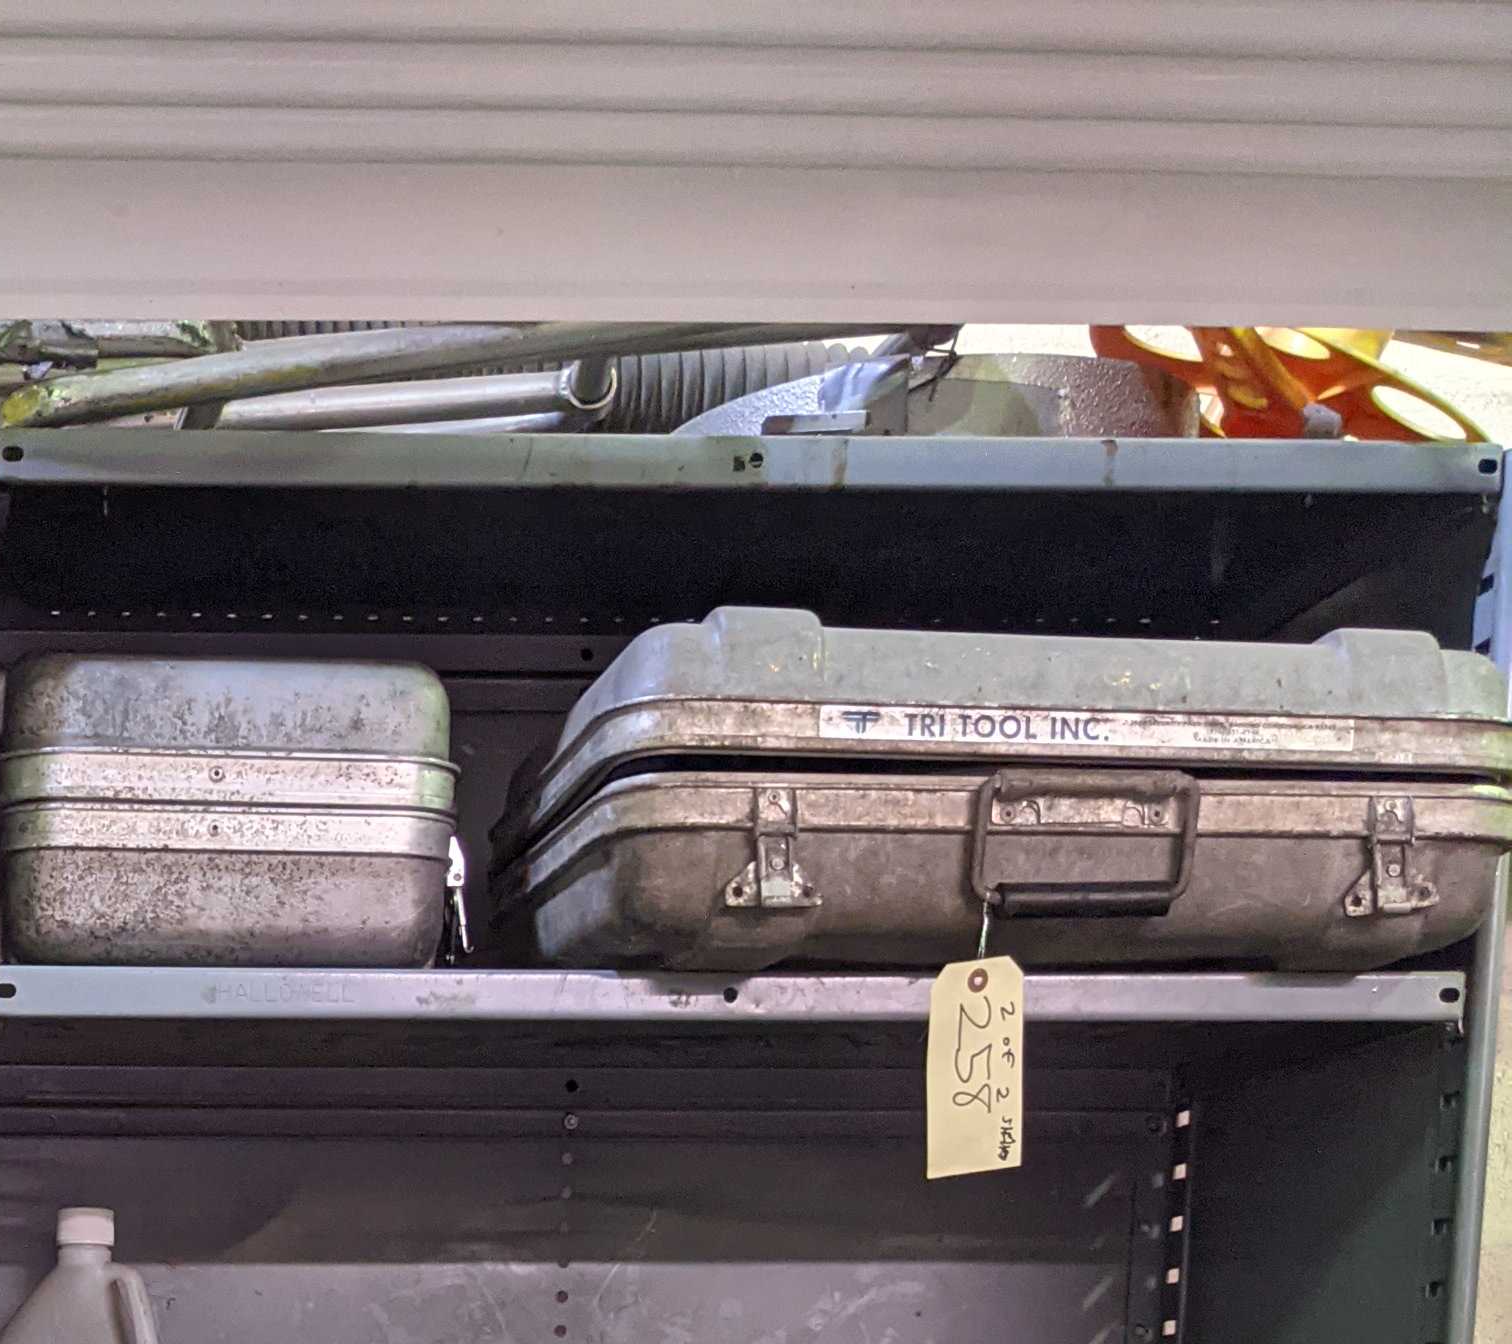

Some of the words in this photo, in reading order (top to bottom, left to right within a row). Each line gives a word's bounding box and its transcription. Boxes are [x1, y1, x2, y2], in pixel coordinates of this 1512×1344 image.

[904, 712, 946, 738] TRI
[959, 714, 1038, 740] TOOL
[1050, 716, 1110, 742] INC.
[1000, 1001, 1016, 1021] 2
[952, 995, 993, 1114] 258
[995, 1087, 1010, 1104] 2
